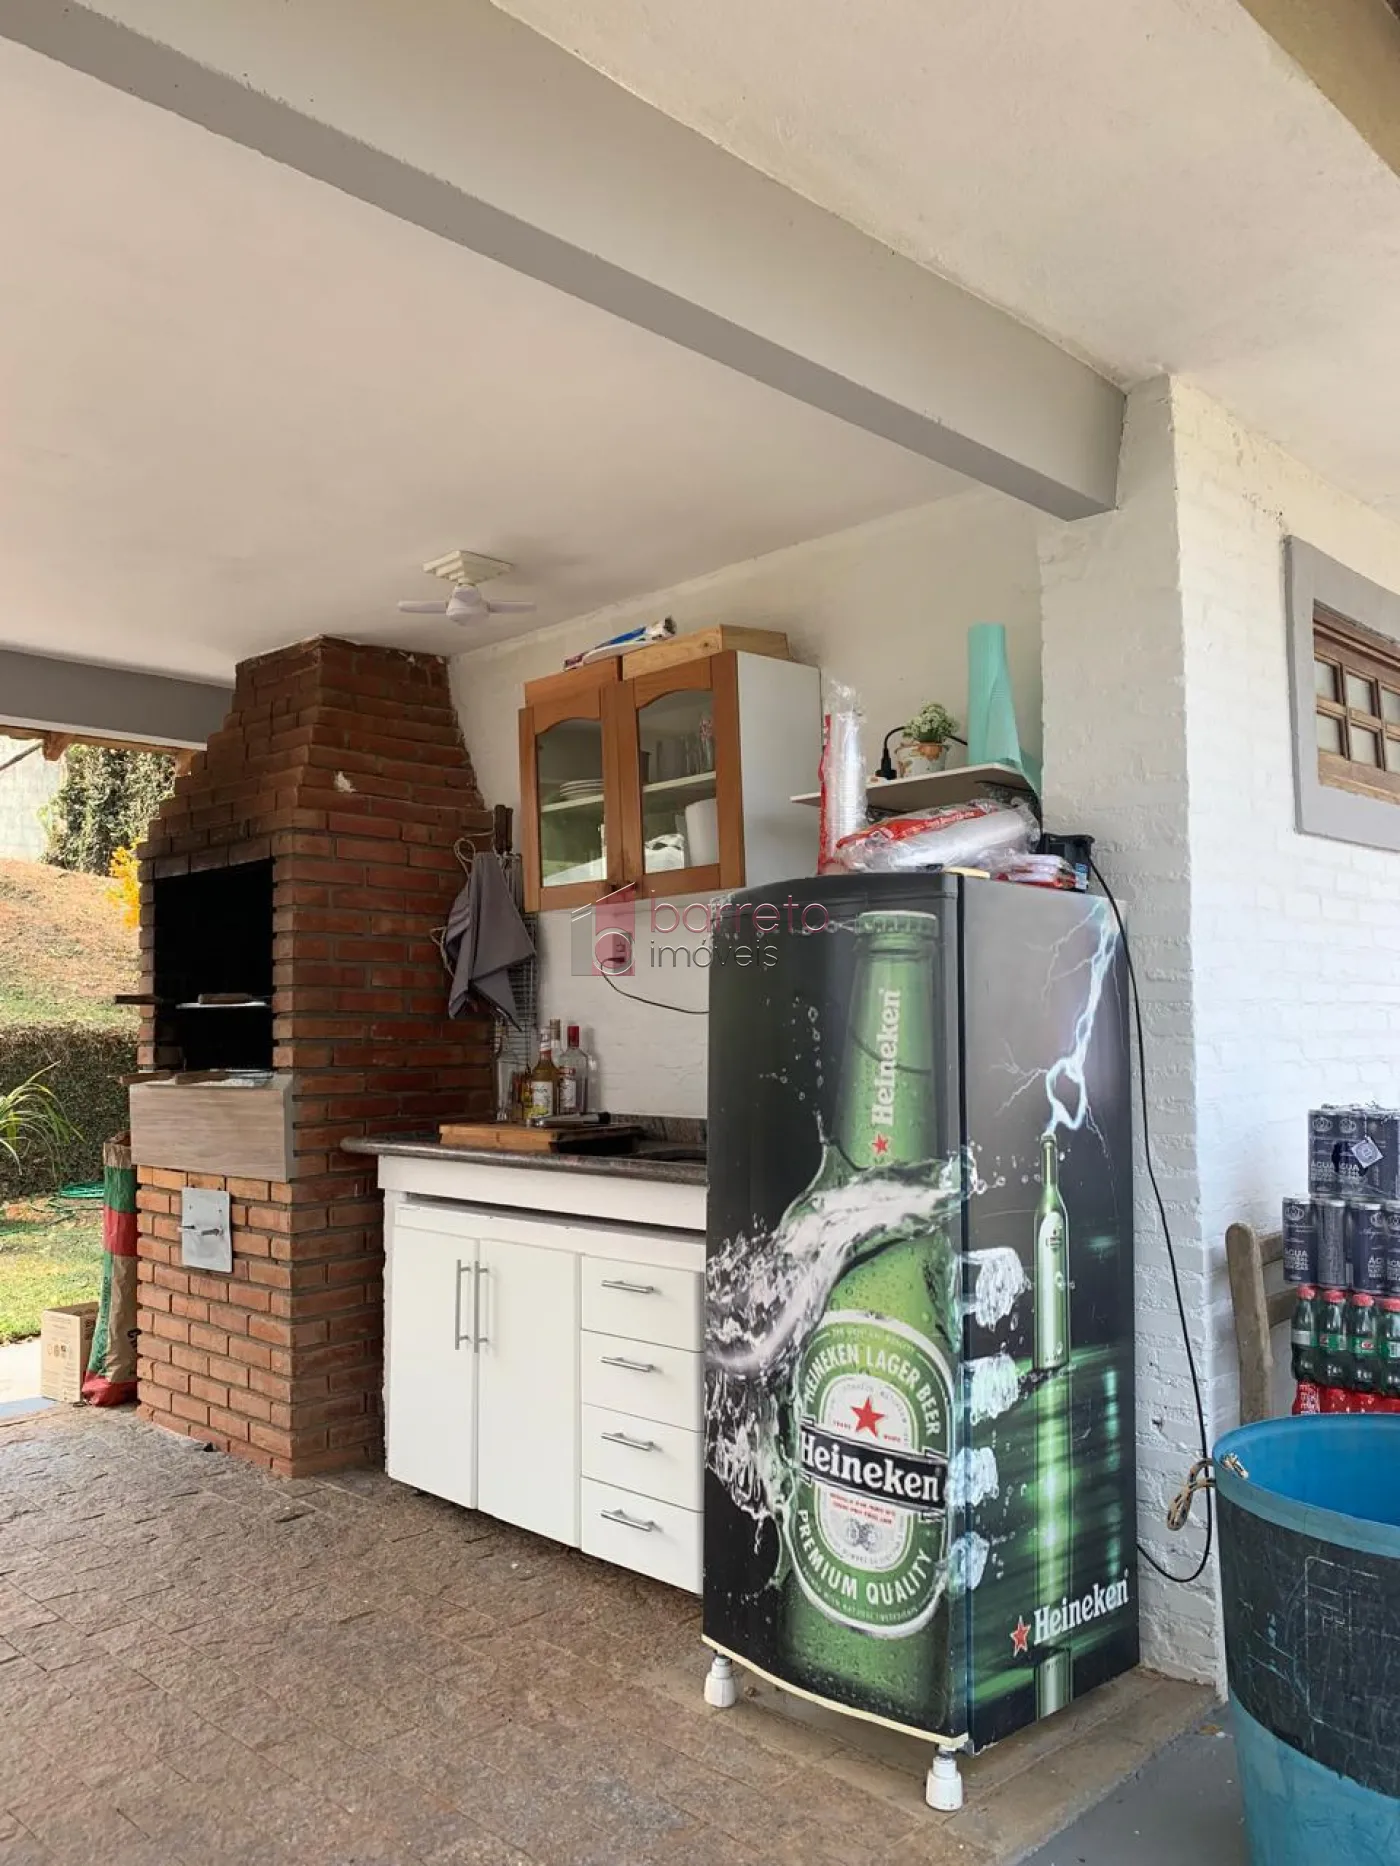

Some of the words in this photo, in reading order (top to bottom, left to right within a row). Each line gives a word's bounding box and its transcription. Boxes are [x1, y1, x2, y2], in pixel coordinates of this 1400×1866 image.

[871, 990, 900, 1126] Heineken
[803, 1343, 860, 1404] HEINEKEN
[867, 1345, 921, 1390] LAGER
[916, 1383, 942, 1436] BEER
[801, 1431, 940, 1502] Heineken
[797, 1509, 858, 1600] PREMIUM
[865, 1548, 932, 1606] QUALITY
[1033, 1579, 1129, 1646] Heineken
